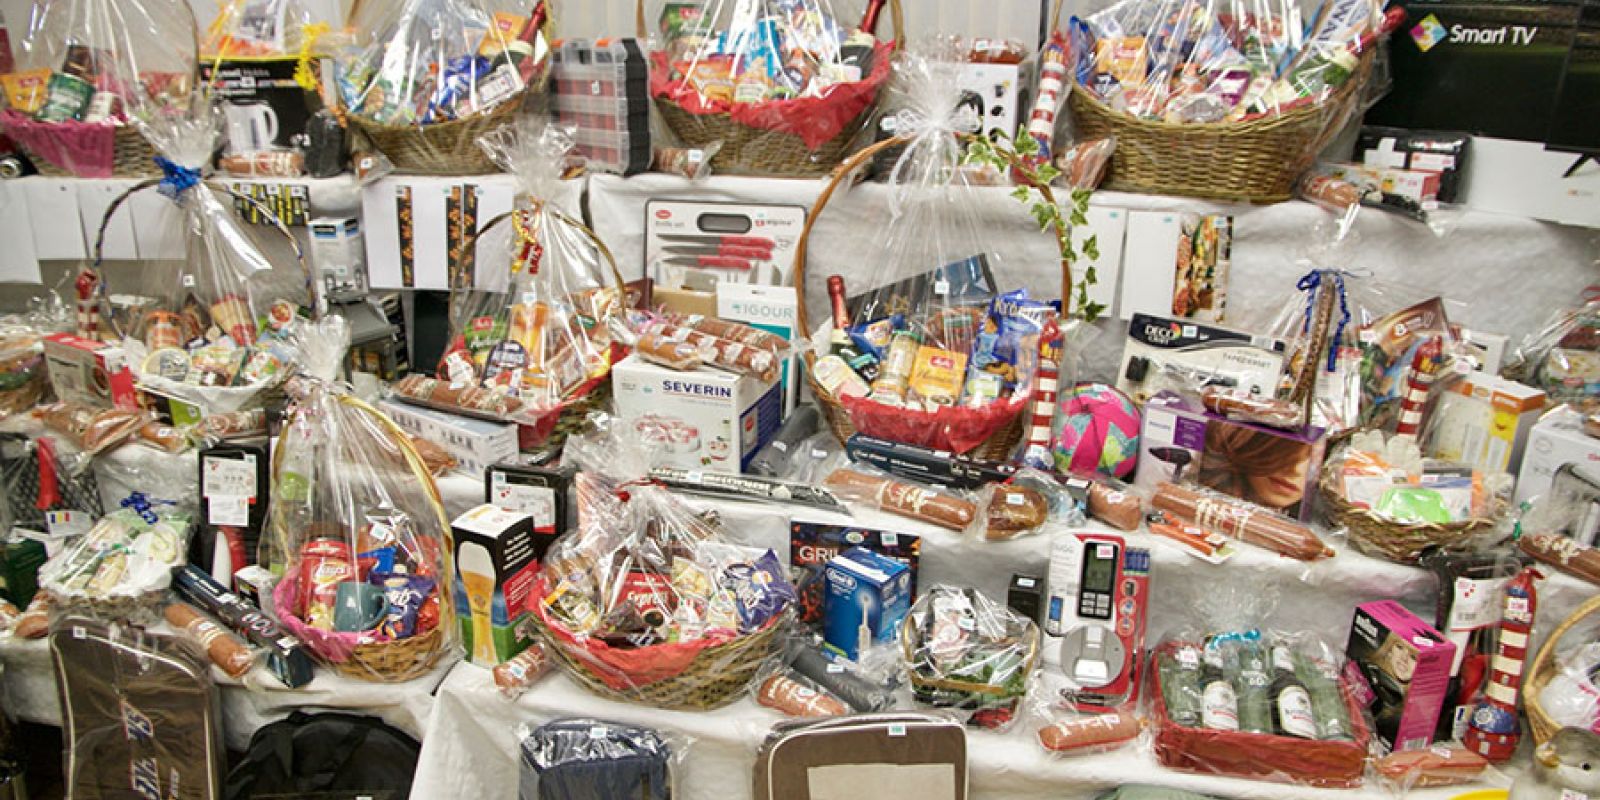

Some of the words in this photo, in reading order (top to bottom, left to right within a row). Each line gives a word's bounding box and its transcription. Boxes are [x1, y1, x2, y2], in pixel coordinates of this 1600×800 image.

[1450, 23, 1506, 45] Smart
[1510, 25, 1538, 46] TV
[1144, 323, 1175, 341] DECO
[662, 379, 732, 398] SEVERIN
